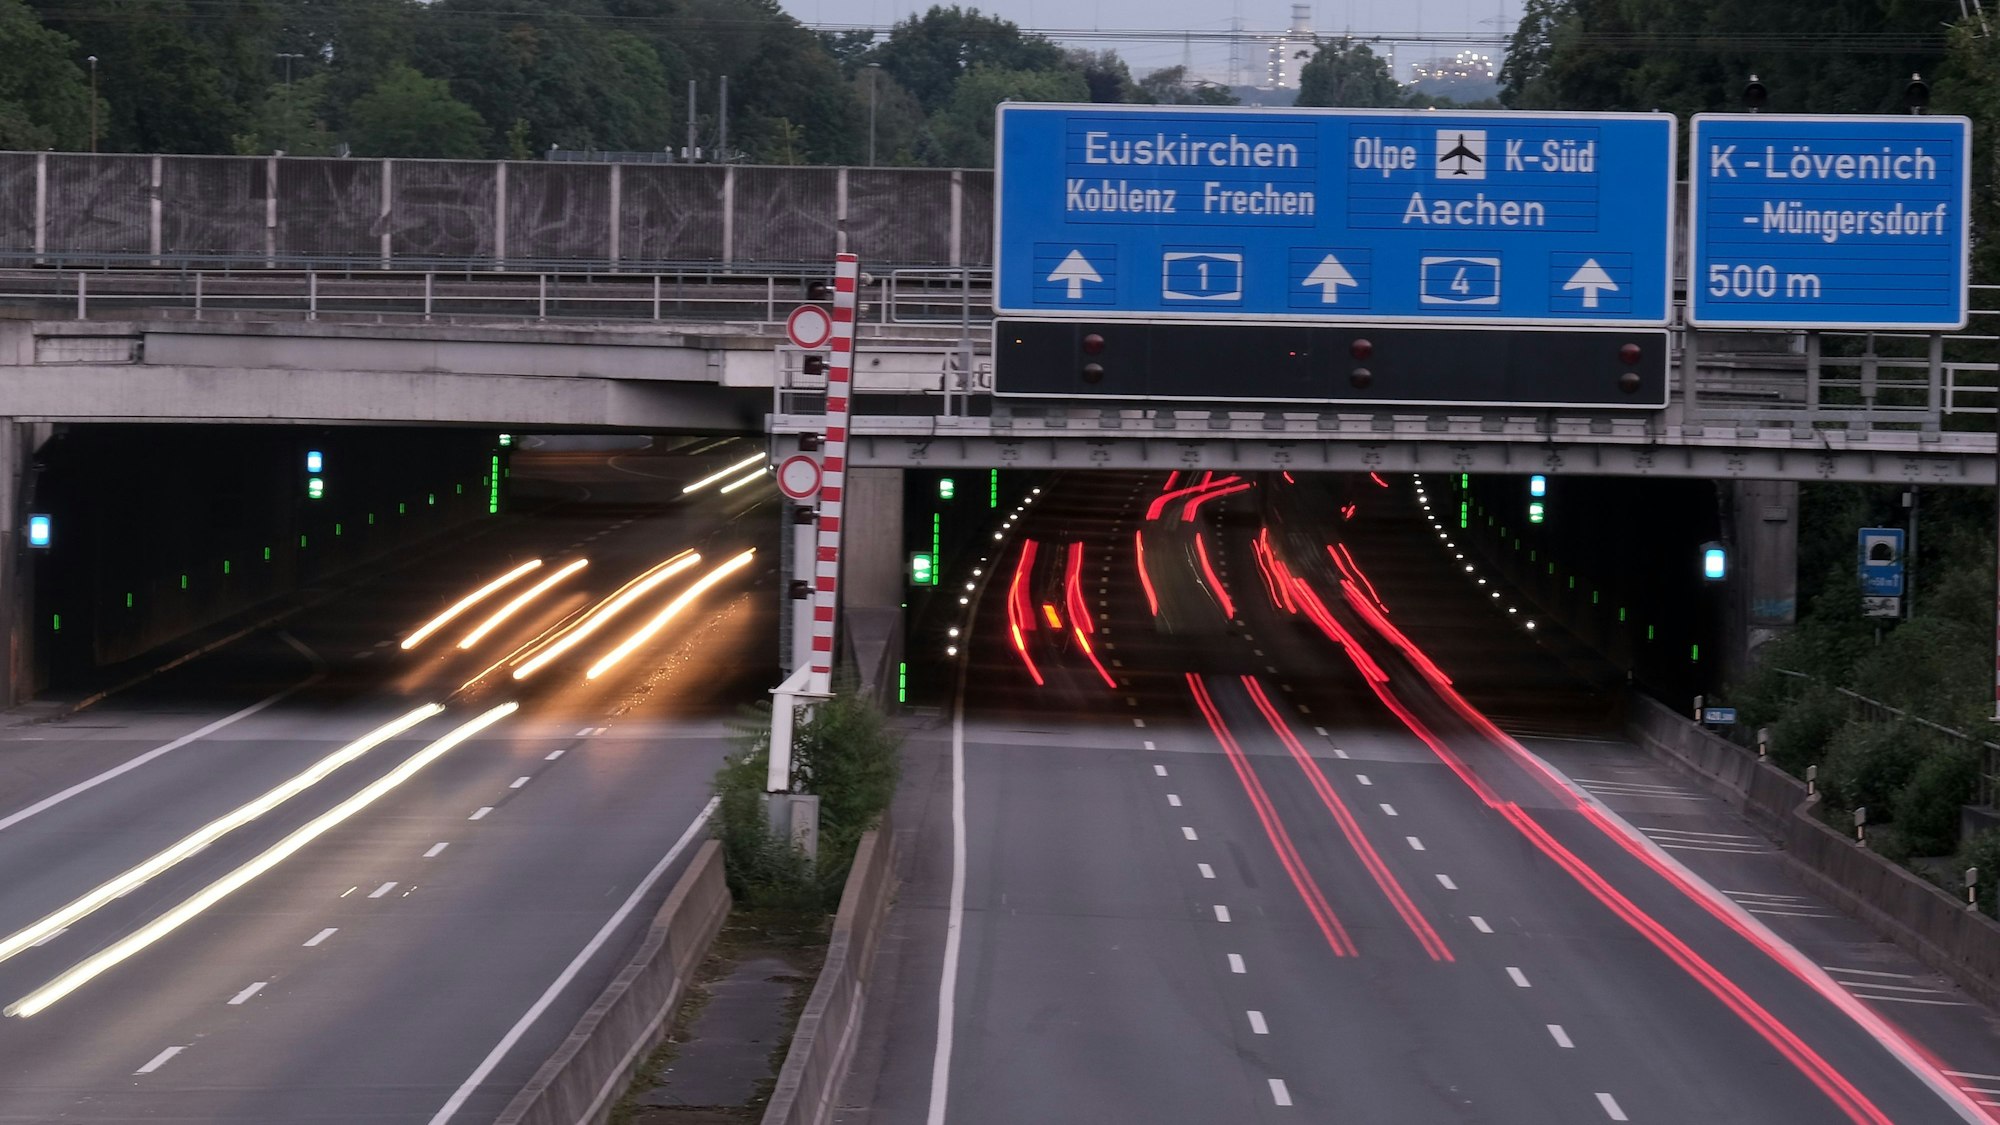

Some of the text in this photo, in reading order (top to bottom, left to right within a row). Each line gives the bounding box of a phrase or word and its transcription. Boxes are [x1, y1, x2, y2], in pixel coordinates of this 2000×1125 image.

[1086, 131, 1297, 167] Euskirchen
[1354, 136, 1594, 178] Olpe K-Süd
[1711, 145, 1935, 180] K-Lövenich
[1067, 178, 1314, 216] Koblenz Frechen
[1402, 191, 1544, 226] Aachen
[1743, 201, 1946, 244] -Müngersdorf
[1197, 262, 1209, 291] 1
[1450, 266, 1470, 295] 4
[1710, 264, 1820, 298] 500 m
